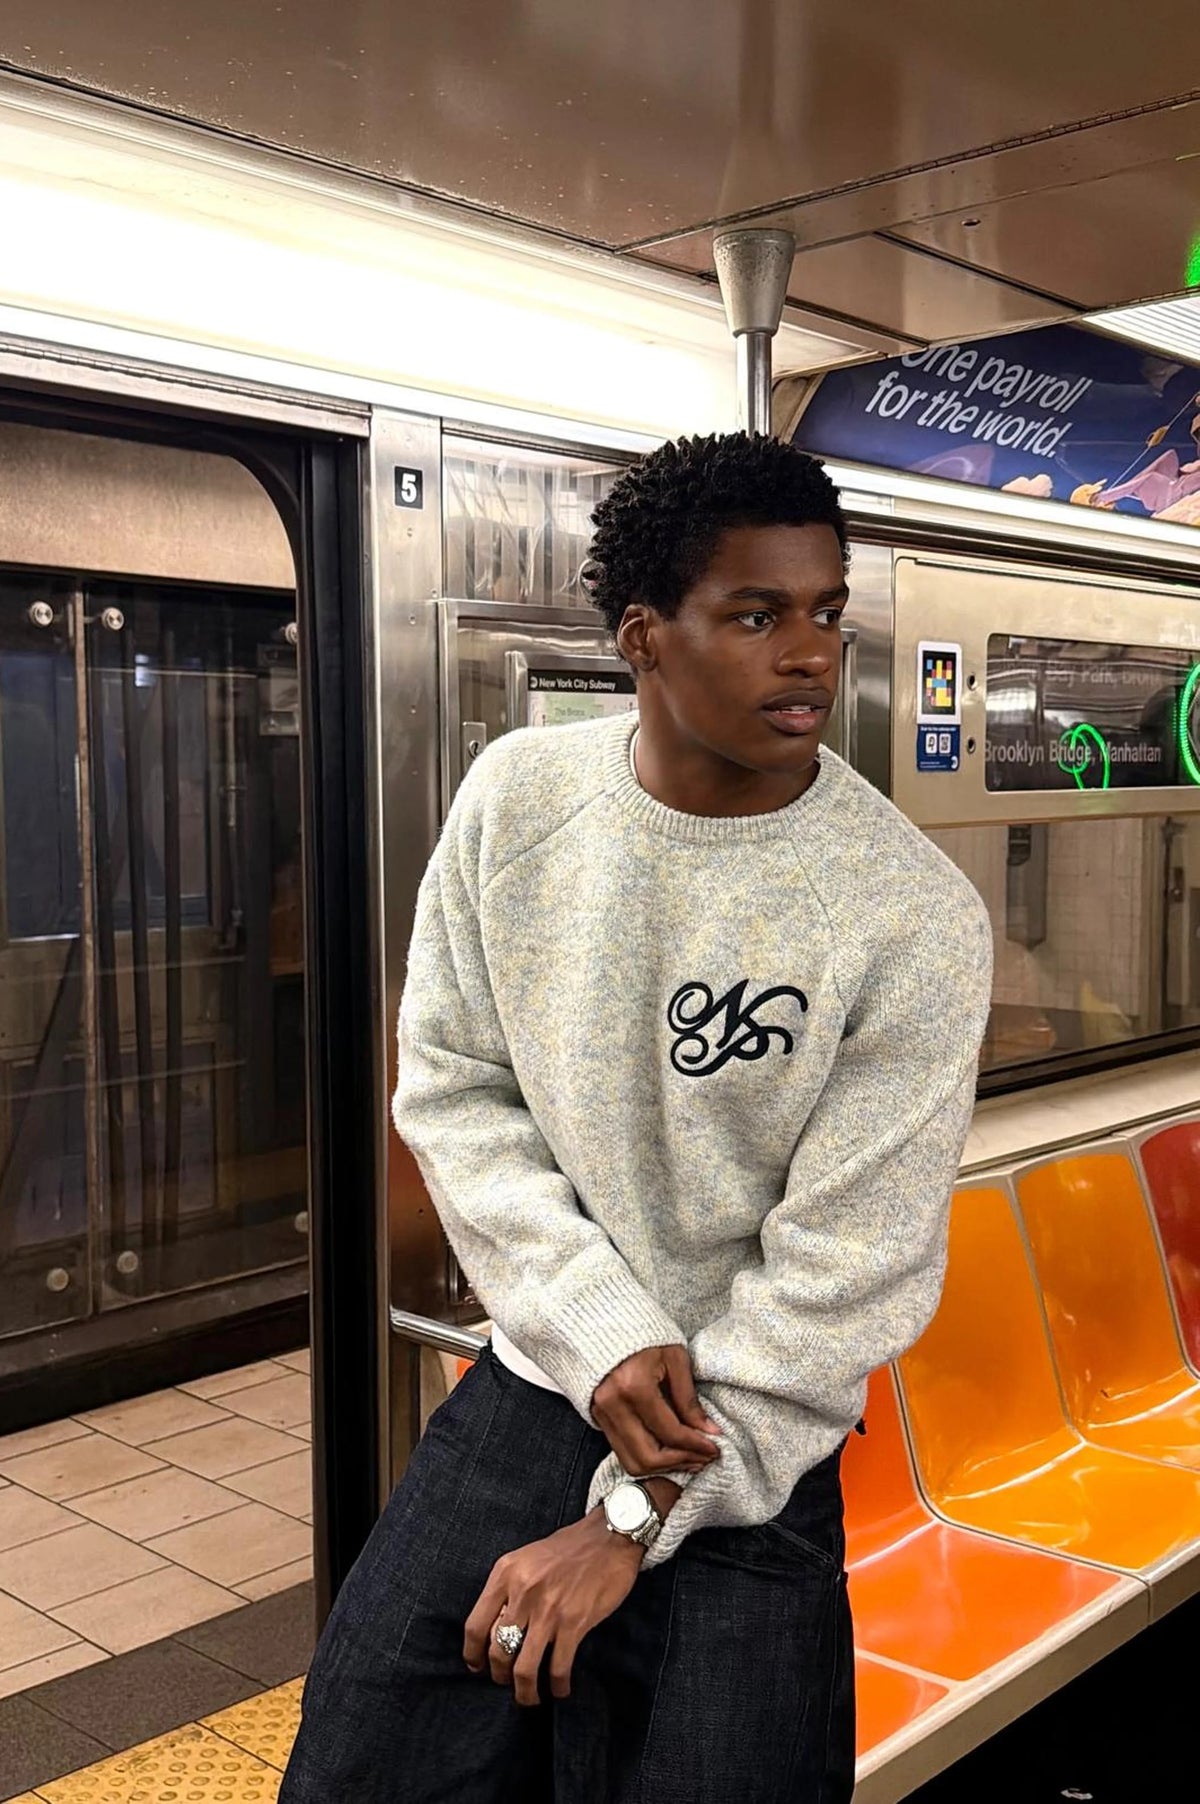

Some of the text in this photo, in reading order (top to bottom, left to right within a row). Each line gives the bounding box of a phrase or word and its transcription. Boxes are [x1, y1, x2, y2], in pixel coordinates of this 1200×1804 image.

[964, 356, 1092, 413] payroll
[864, 371, 1072, 458] for the world.
[401, 473, 417, 503] 5
[539, 678, 616, 692] New York City Subway
[984, 739, 1044, 767] Brooklyn
[1050, 740, 1096, 767] Bridge,
